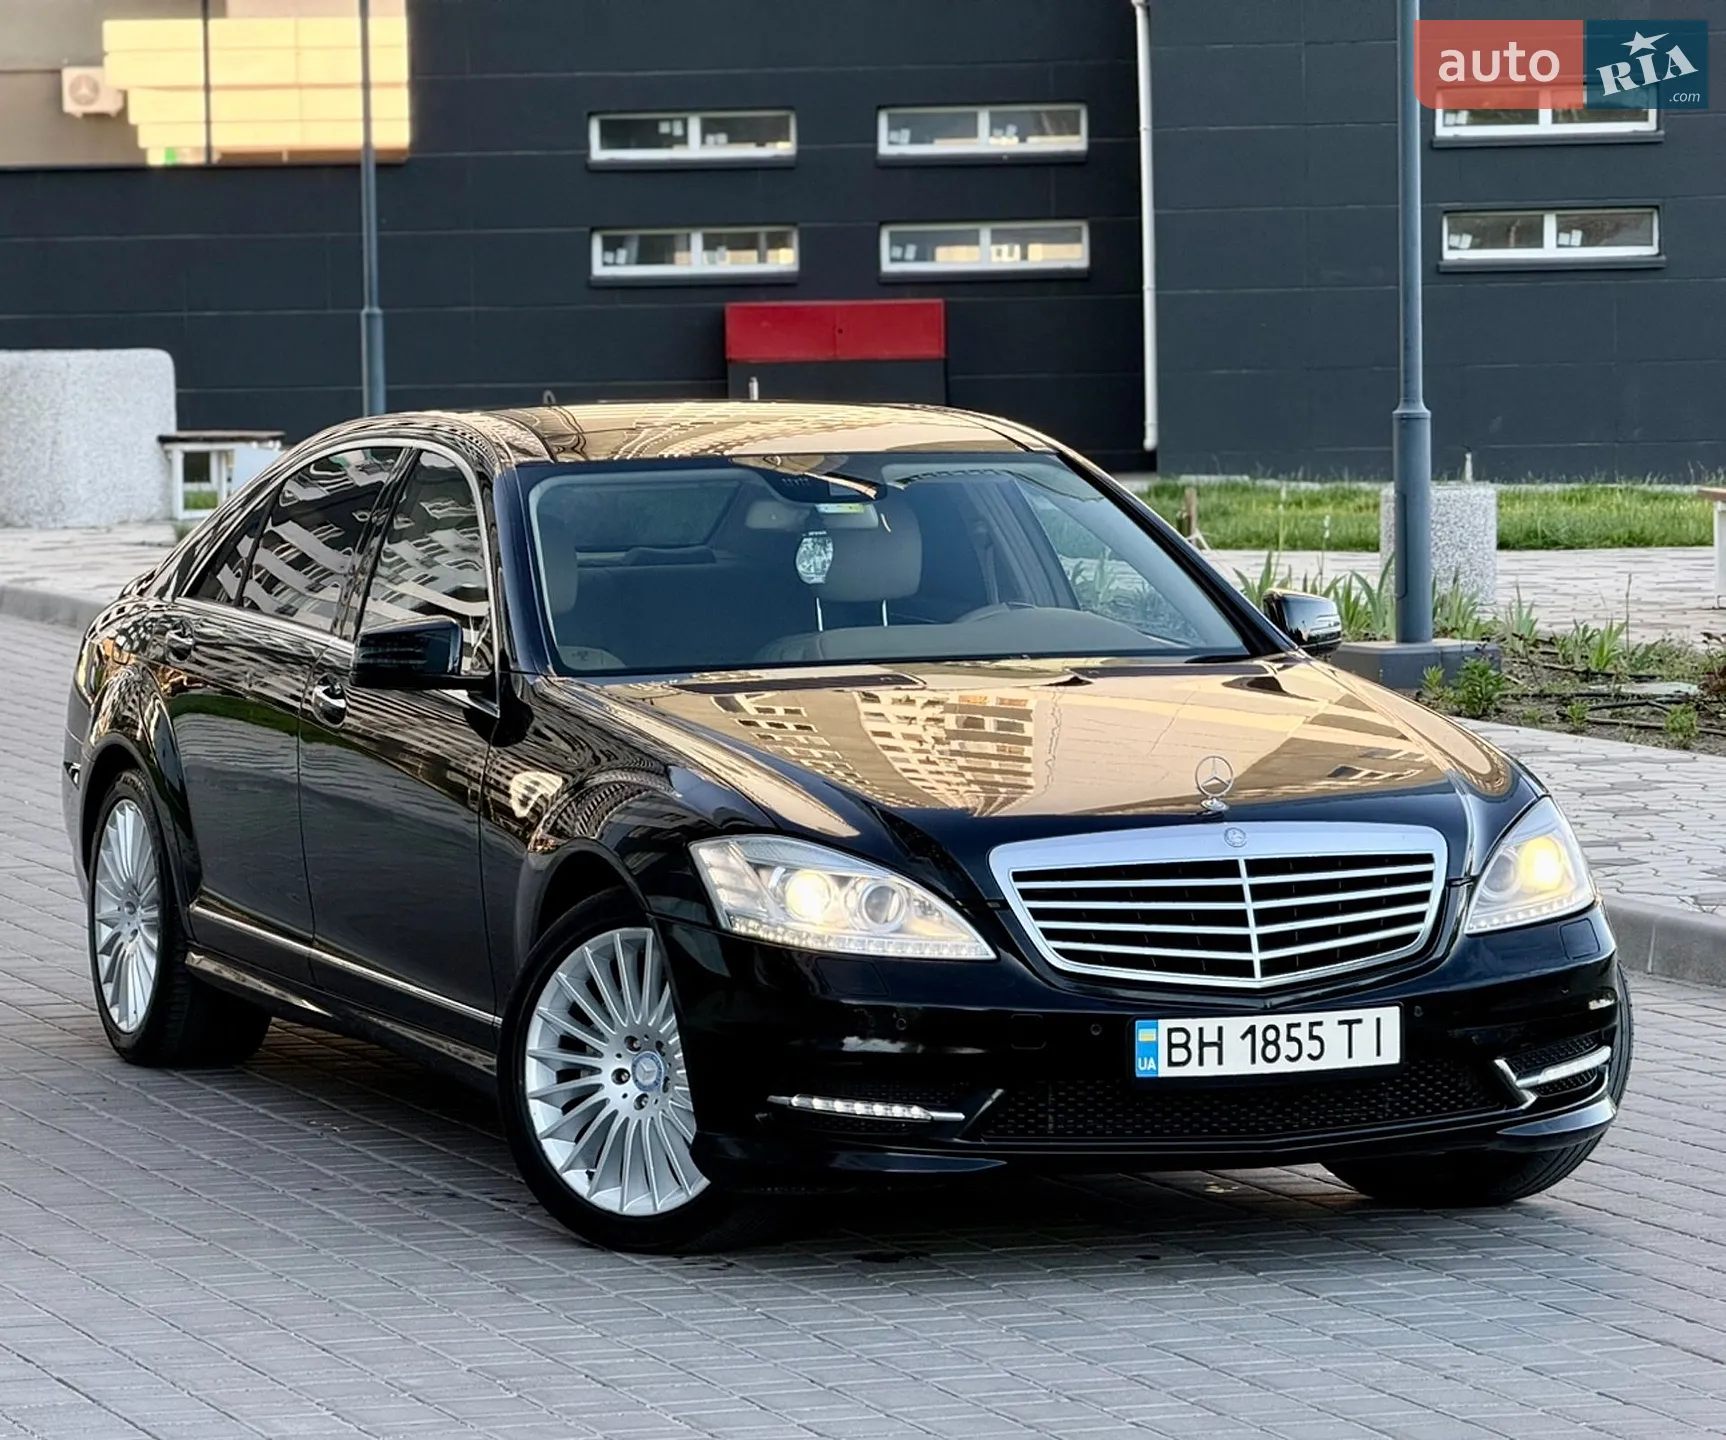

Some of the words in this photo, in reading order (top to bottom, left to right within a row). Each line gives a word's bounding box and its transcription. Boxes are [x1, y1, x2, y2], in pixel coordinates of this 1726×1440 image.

[1166, 1025, 1224, 1067] BH
[1239, 1020, 1325, 1065] 1855
[1337, 1017, 1381, 1059] TI
[1137, 1057, 1157, 1071] UA
